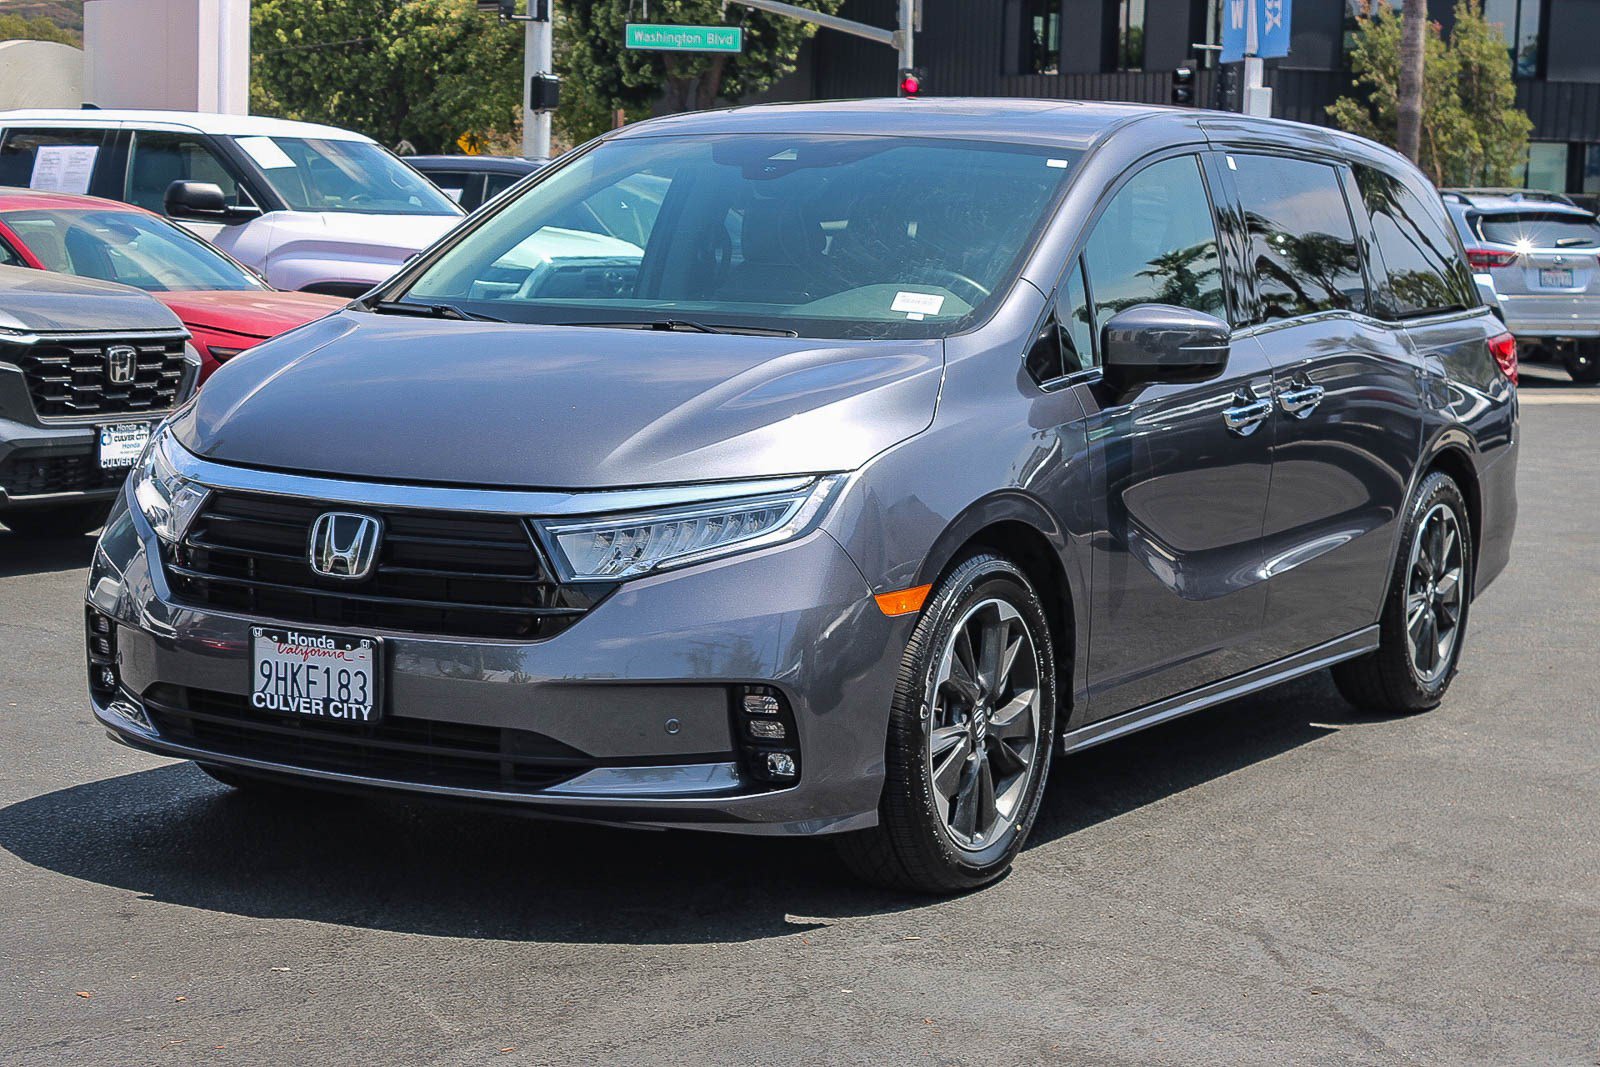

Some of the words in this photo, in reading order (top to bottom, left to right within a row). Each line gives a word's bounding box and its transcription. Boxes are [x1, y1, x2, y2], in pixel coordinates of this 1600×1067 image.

[634, 31, 702, 46] Washington
[707, 32, 735, 46] Blvd
[114, 434, 135, 442] CULVER
[287, 631, 335, 650] Honda
[277, 642, 354, 662] California
[260, 659, 368, 705] 9HKF183
[252, 692, 324, 716] CULVER
[329, 701, 372, 721] CITY
